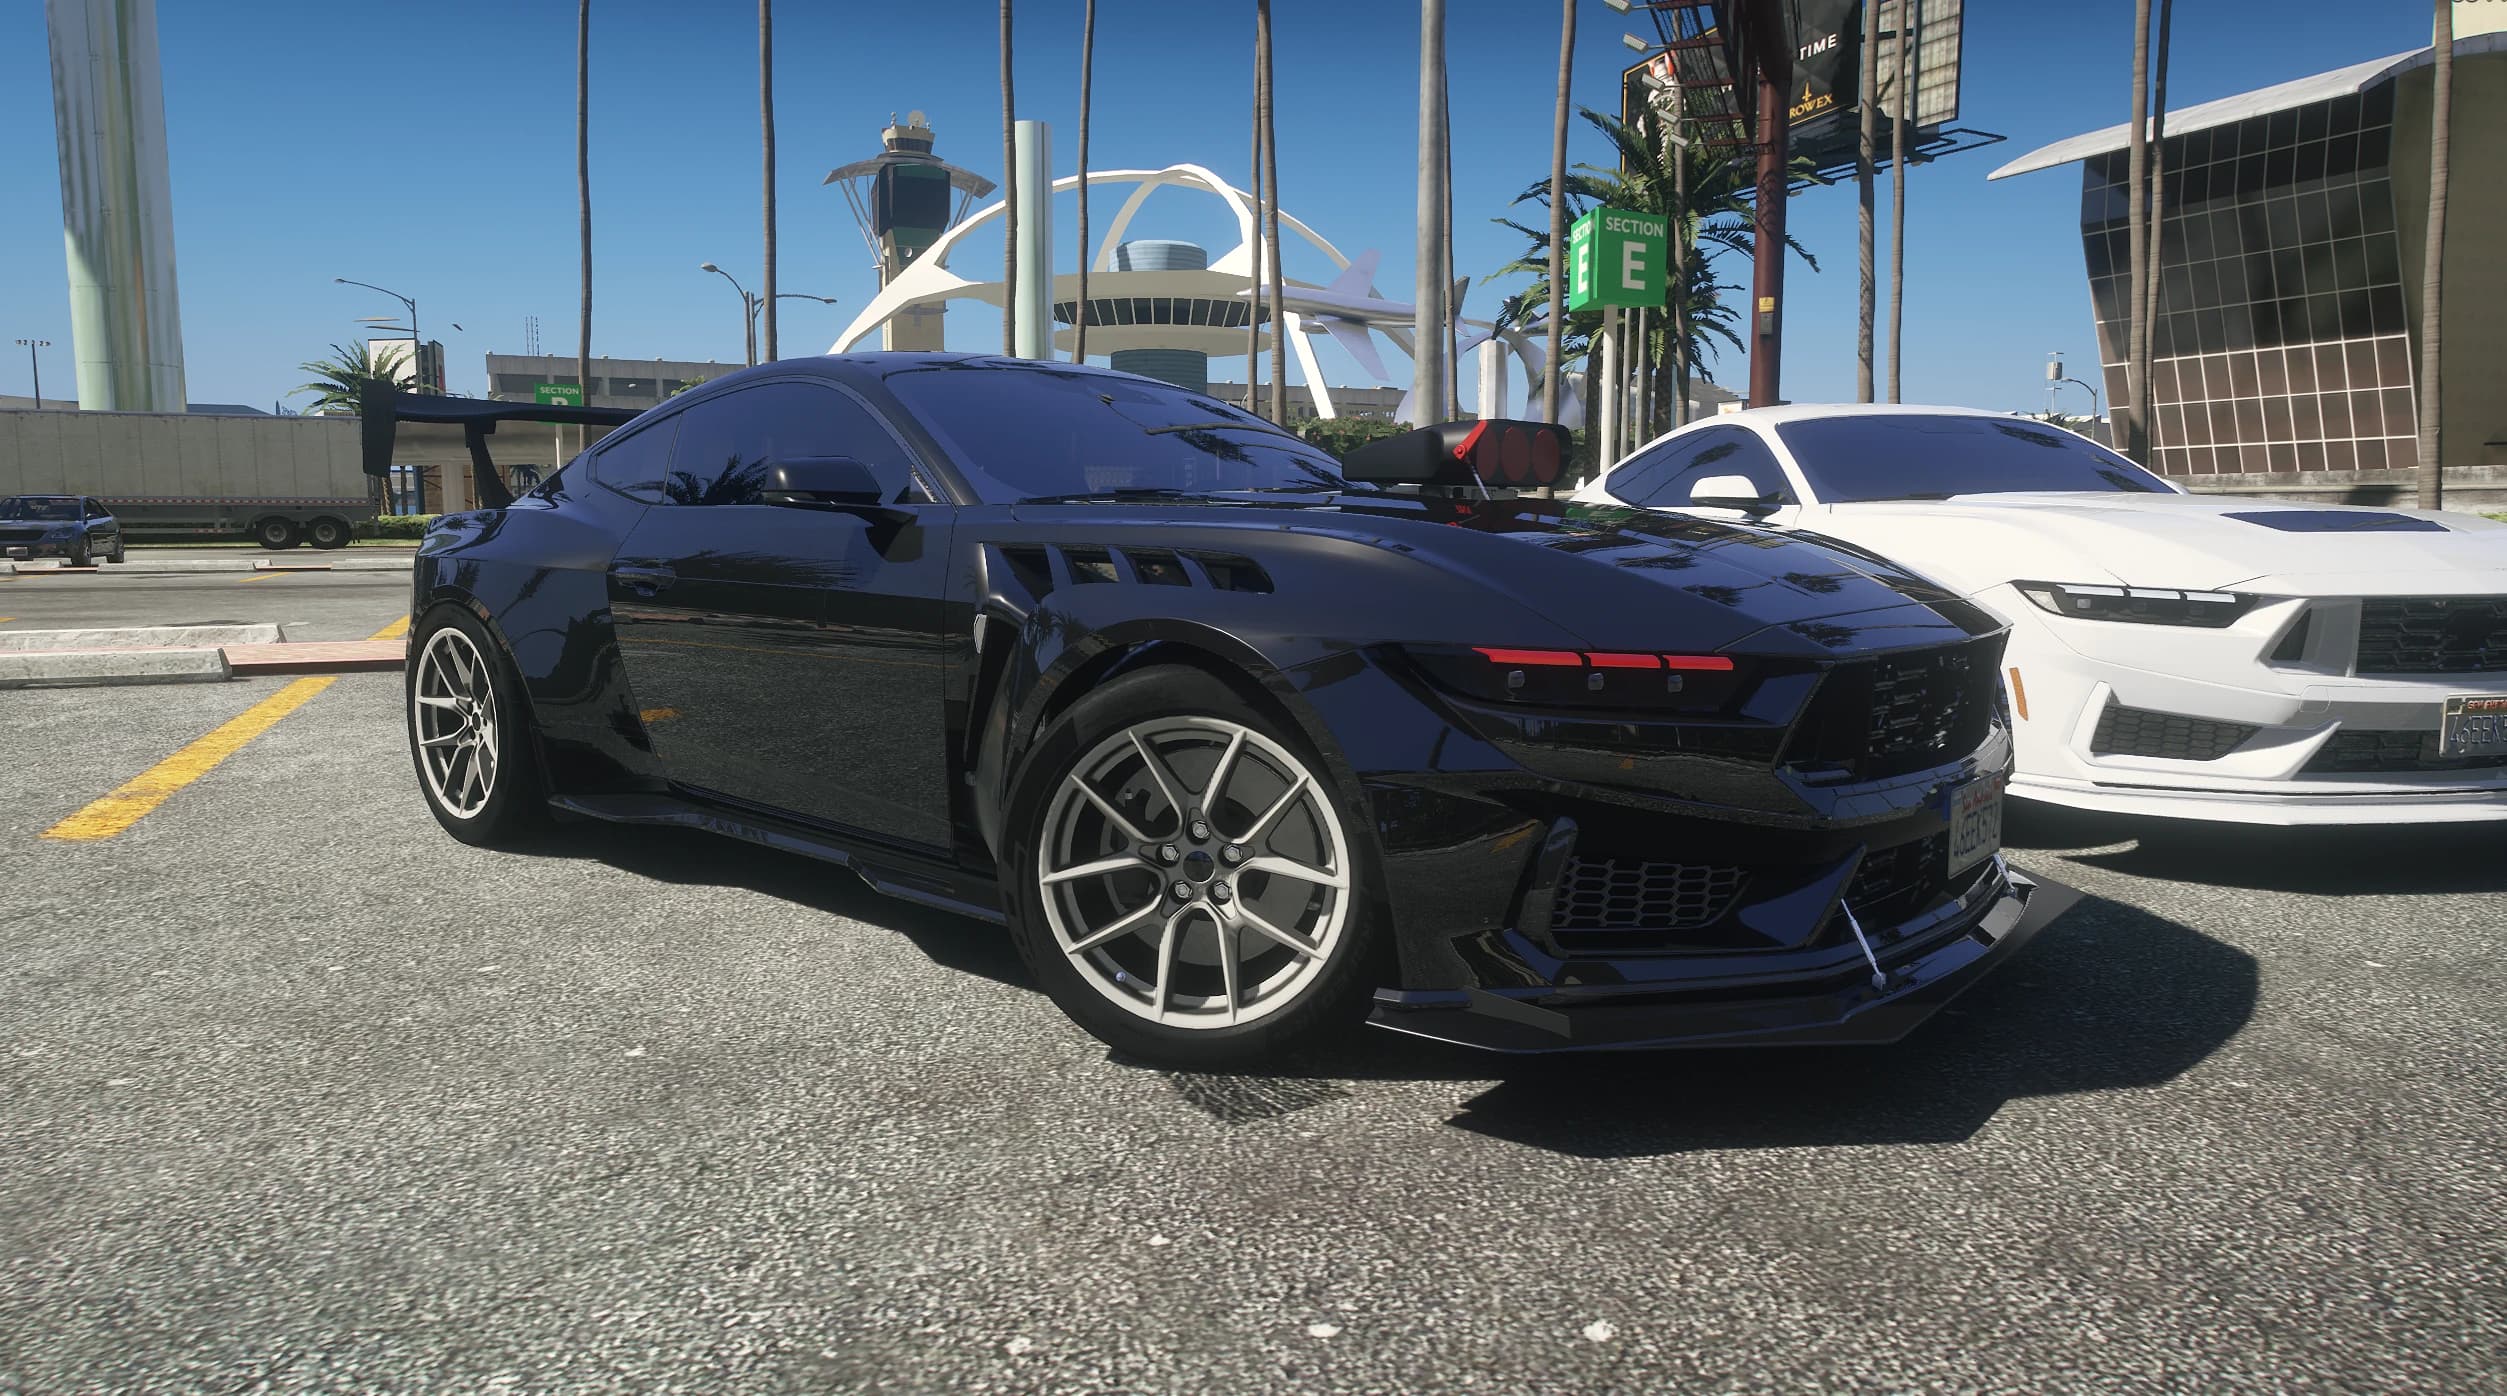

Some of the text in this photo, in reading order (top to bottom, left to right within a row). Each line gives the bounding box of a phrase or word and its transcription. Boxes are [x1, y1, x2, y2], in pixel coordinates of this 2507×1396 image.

[1799, 33, 1838, 61] TIME
[1789, 93, 1833, 119] ROWEX
[1605, 216, 1664, 238] SECTION
[1577, 242, 1589, 294] E
[1622, 240, 1647, 290] E
[539, 386, 580, 395] SECTION
[1953, 801, 1998, 857] 46EEK572
